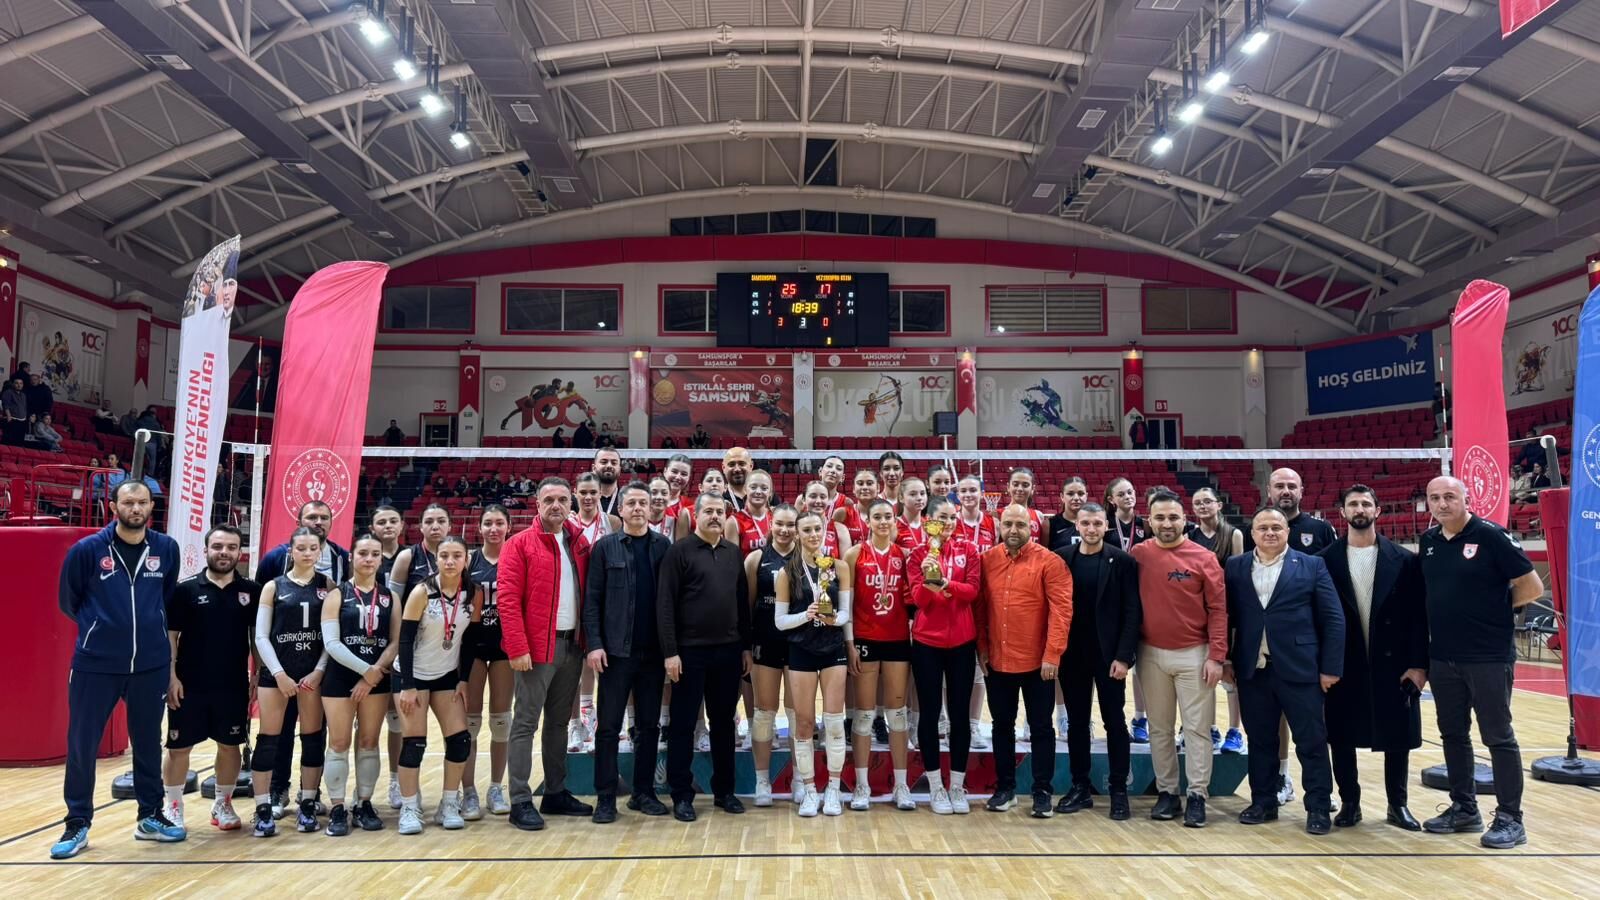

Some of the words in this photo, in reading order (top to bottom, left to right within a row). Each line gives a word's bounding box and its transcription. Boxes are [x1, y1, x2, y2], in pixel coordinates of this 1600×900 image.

[782, 284, 797, 295] 25
[820, 284, 831, 295] 17
[791, 303, 818, 314] 18:39
[777, 317, 783, 327] 3
[801, 317, 806, 327] 3
[823, 317, 829, 327] 0
[1318, 372, 1349, 388] HOŞ
[1352, 360, 1427, 383] GELDİNİZ
[688, 392, 750, 403] SAMSUN
[434, 402, 447, 410] B2
[1156, 401, 1168, 410] B1
[300, 602, 309, 628] 1
[483, 618, 498, 626] SK
[295, 642, 311, 651] SK
[359, 645, 374, 654] SK
